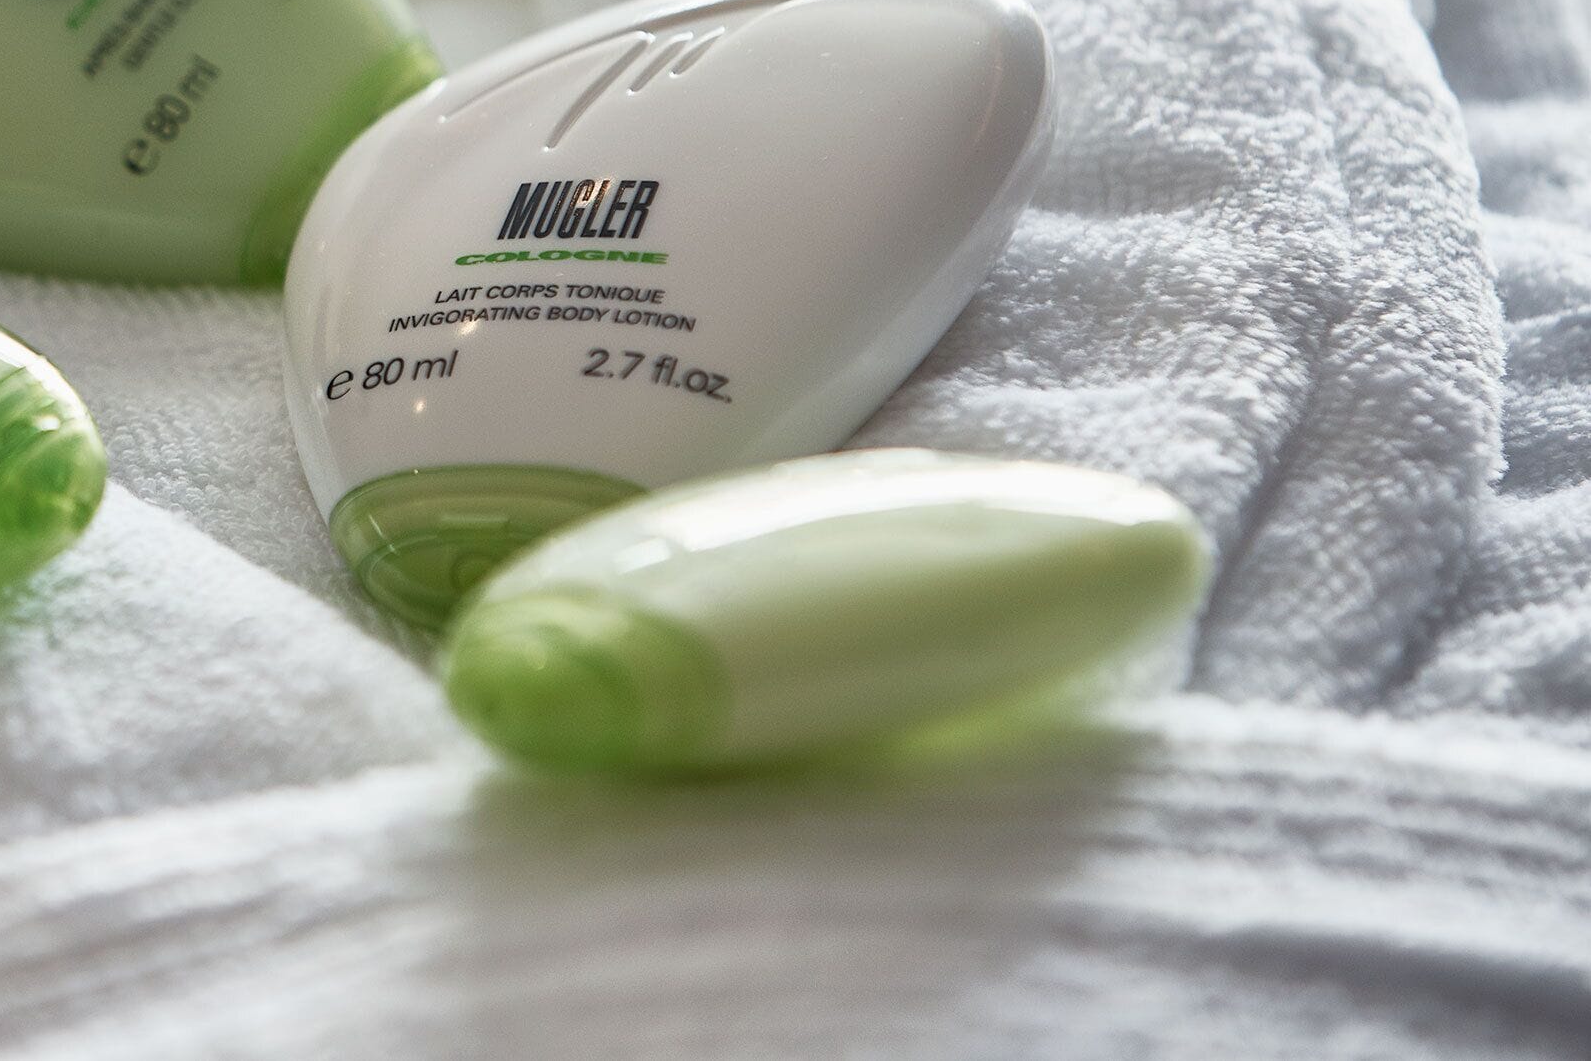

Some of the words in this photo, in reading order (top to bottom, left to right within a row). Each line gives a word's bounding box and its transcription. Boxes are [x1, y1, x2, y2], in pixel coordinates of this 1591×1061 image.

[143, 93, 191, 143] 80
[178, 52, 221, 105] ml
[496, 179, 660, 241] MUGLER
[455, 249, 670, 266] COLOGNE
[434, 286, 483, 305] LAIT
[485, 284, 560, 300] CORPS
[566, 284, 667, 305] TONIQUE
[388, 306, 541, 333] INVIGORATING
[546, 306, 610, 323] BODY
[614, 310, 697, 333] LOTION
[362, 356, 405, 390] 80
[412, 348, 459, 382] ml
[582, 347, 646, 380] 2.7
